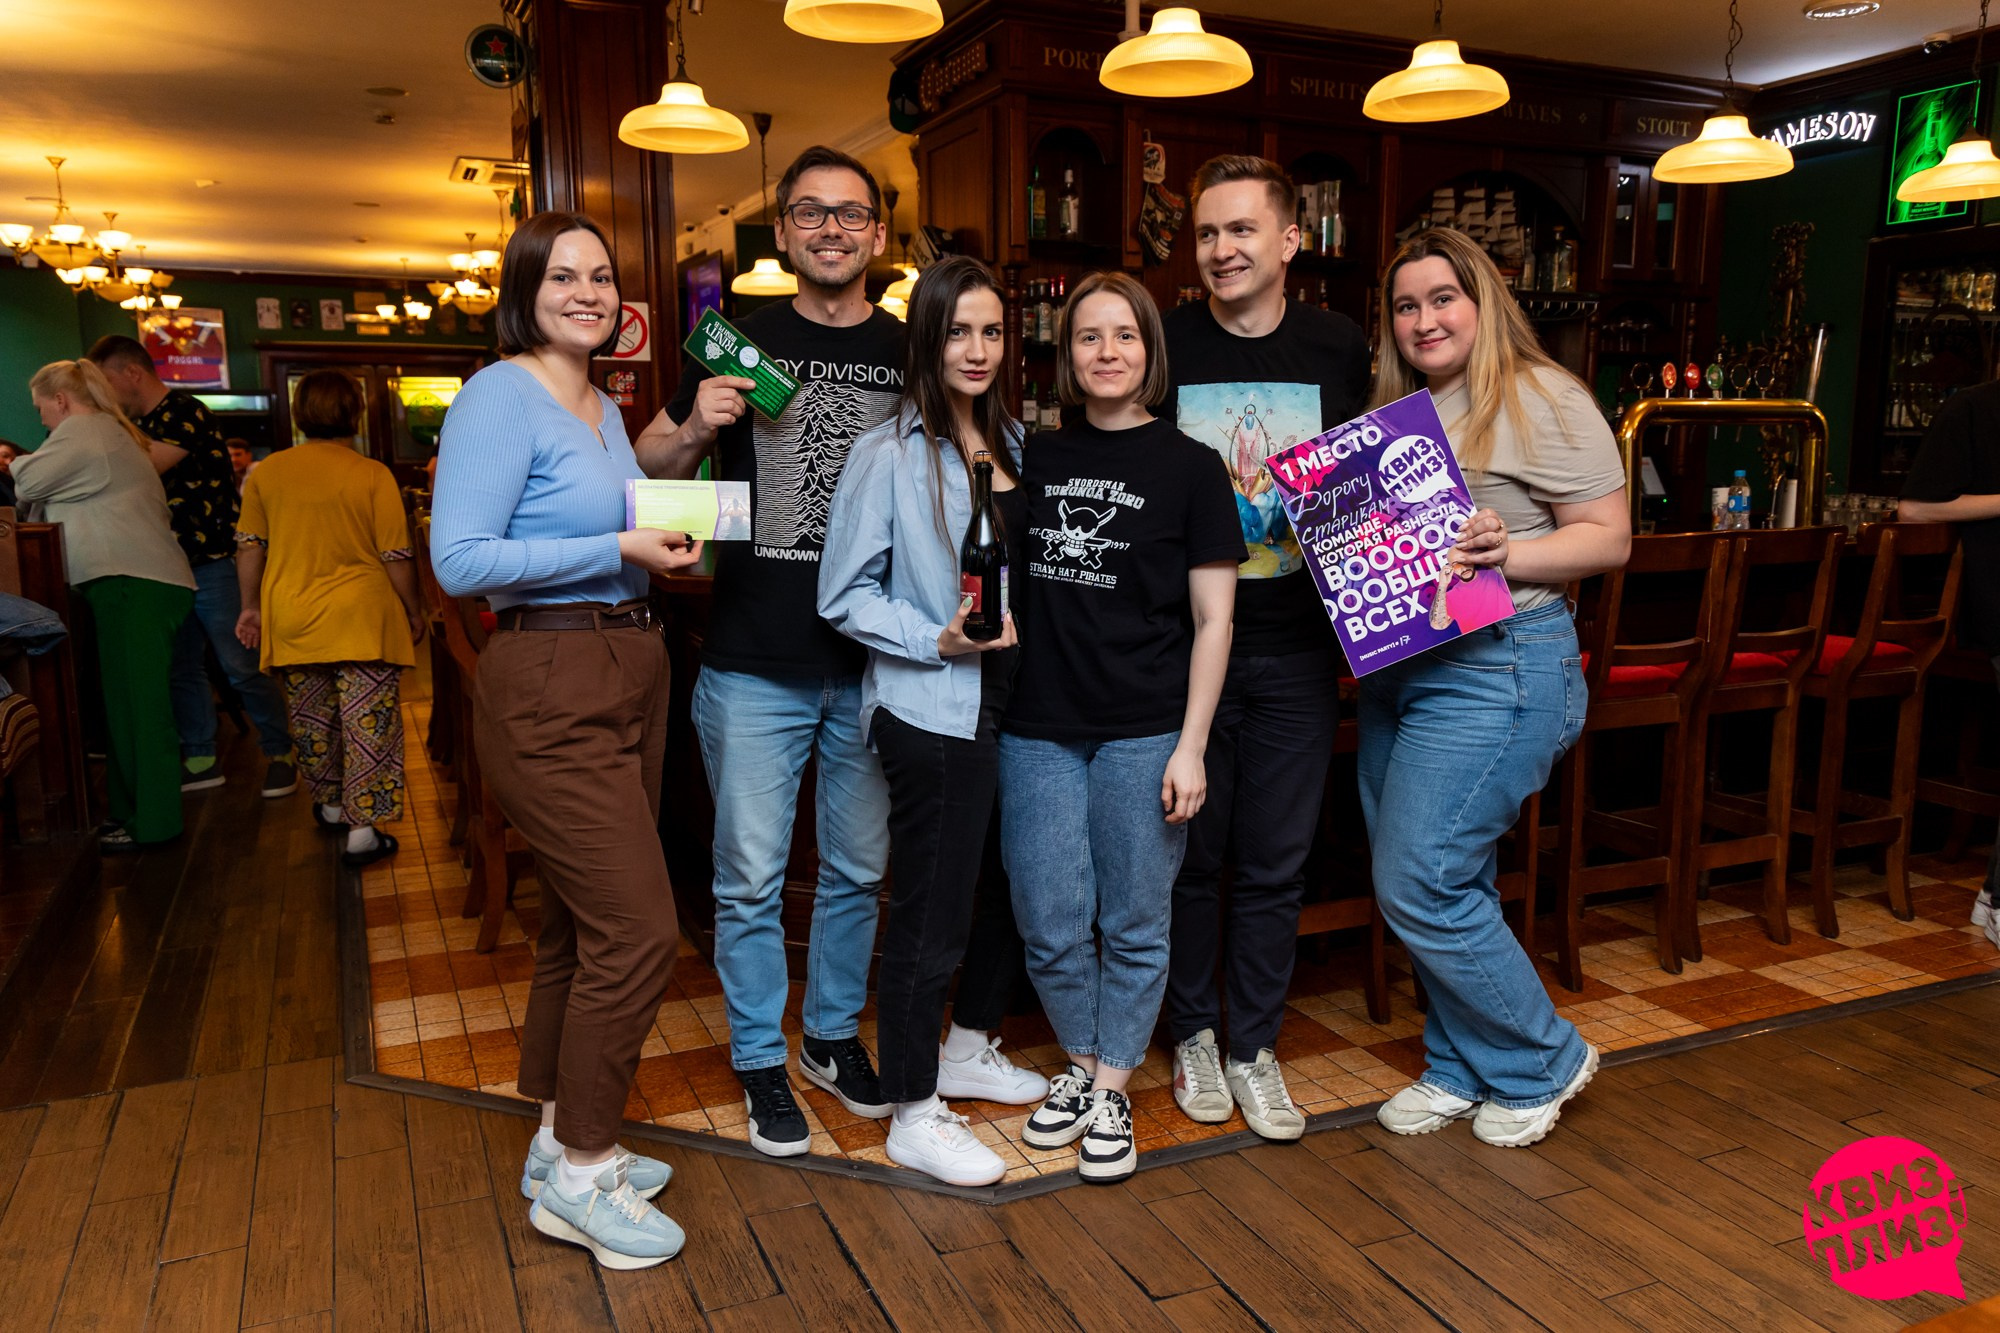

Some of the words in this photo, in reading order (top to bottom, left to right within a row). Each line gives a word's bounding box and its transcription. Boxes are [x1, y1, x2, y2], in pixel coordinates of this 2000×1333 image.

[1636, 116, 1692, 138] STOUT
[1761, 111, 1878, 149] AMESON
[702, 322, 738, 357] TRINITY
[810, 361, 904, 386] DIVISION
[1280, 463, 1295, 482] 1
[1296, 425, 1383, 477] МЕСТО
[1068, 478, 1126, 492] SWORDSMAN
[1107, 490, 1146, 510] ZORO
[1110, 541, 1131, 551] 1997
[1312, 516, 1387, 556] КОМАНДЕ,
[1317, 532, 1383, 569] КОТОРАЯ
[1384, 501, 1460, 540] РАЗНЕСЛА
[754, 545, 820, 563] UNKNOWN
[1029, 562, 1057, 575] STRAW
[1058, 566, 1078, 578] HAT
[1079, 570, 1118, 585] PIRATES
[1343, 589, 1429, 643] ВСЕХ
